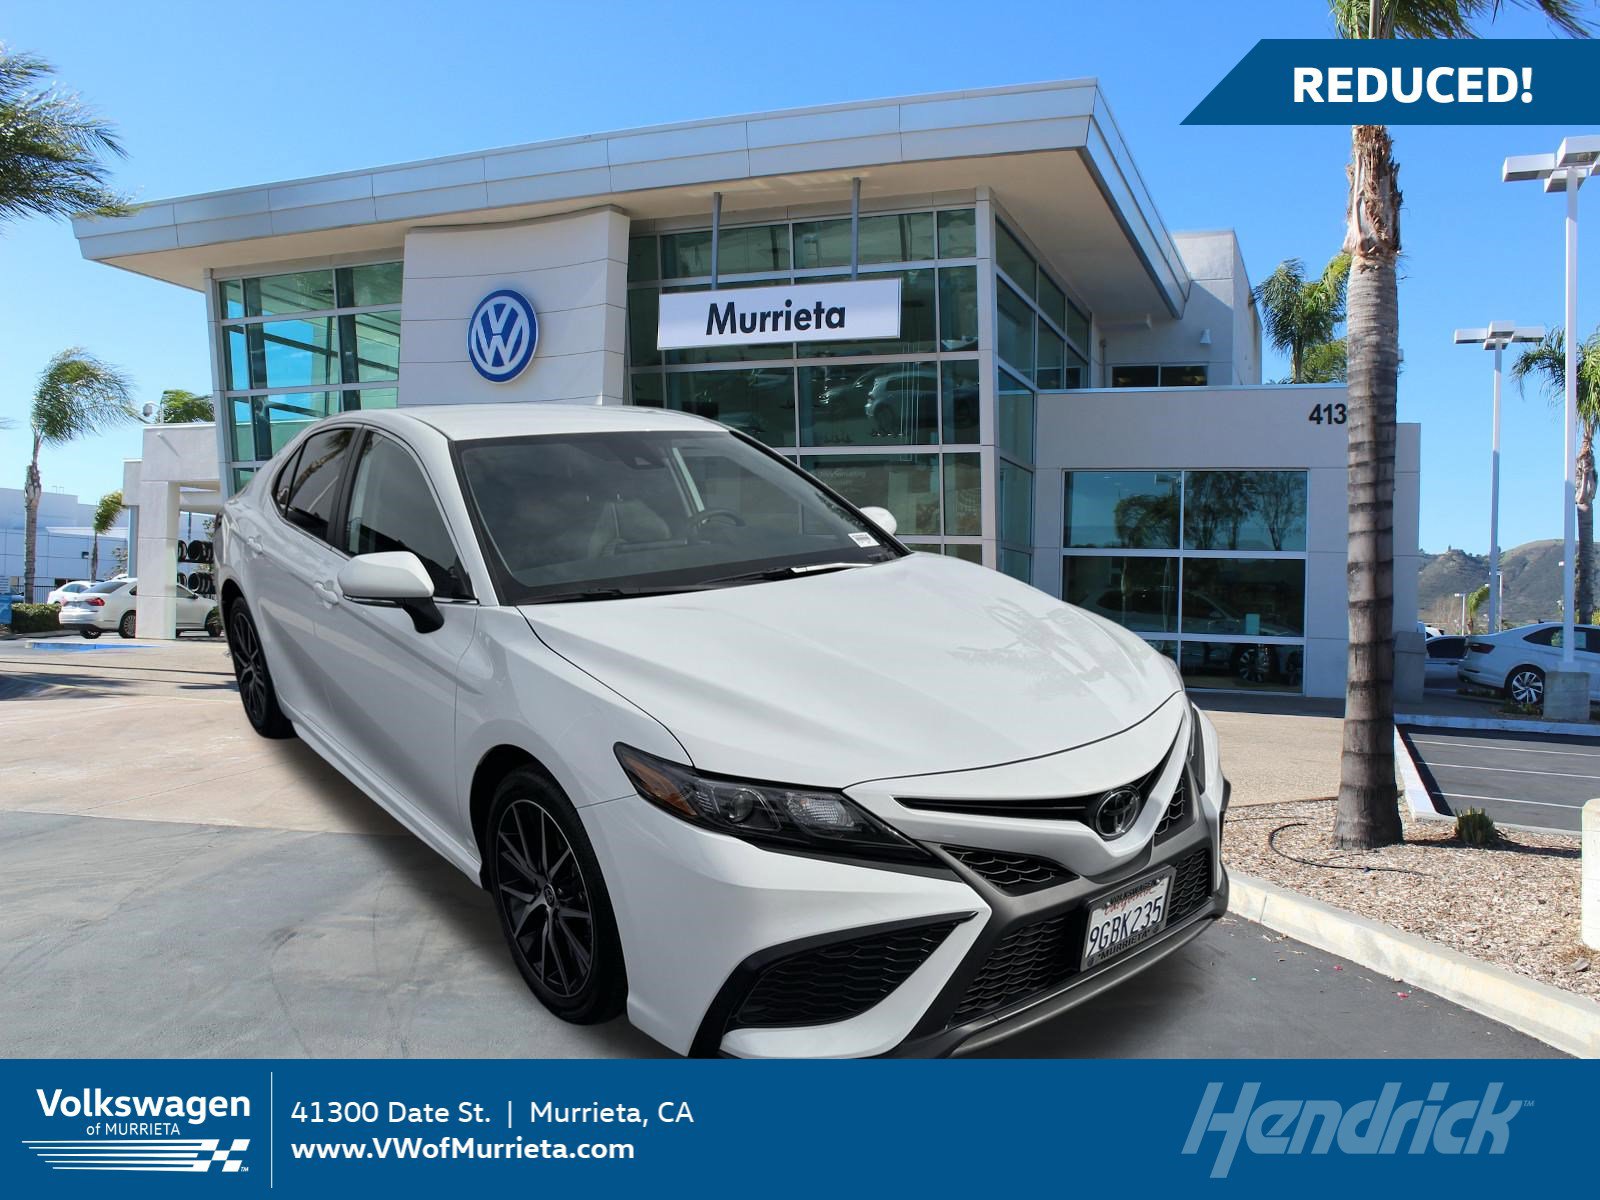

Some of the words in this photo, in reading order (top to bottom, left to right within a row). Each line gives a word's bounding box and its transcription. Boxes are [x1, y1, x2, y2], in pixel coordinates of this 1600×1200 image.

[705, 298, 846, 336] Murrieta
[1308, 403, 1347, 425] 413
[1086, 896, 1163, 958] 9GBK235
[1100, 931, 1148, 960] MURRIETA
